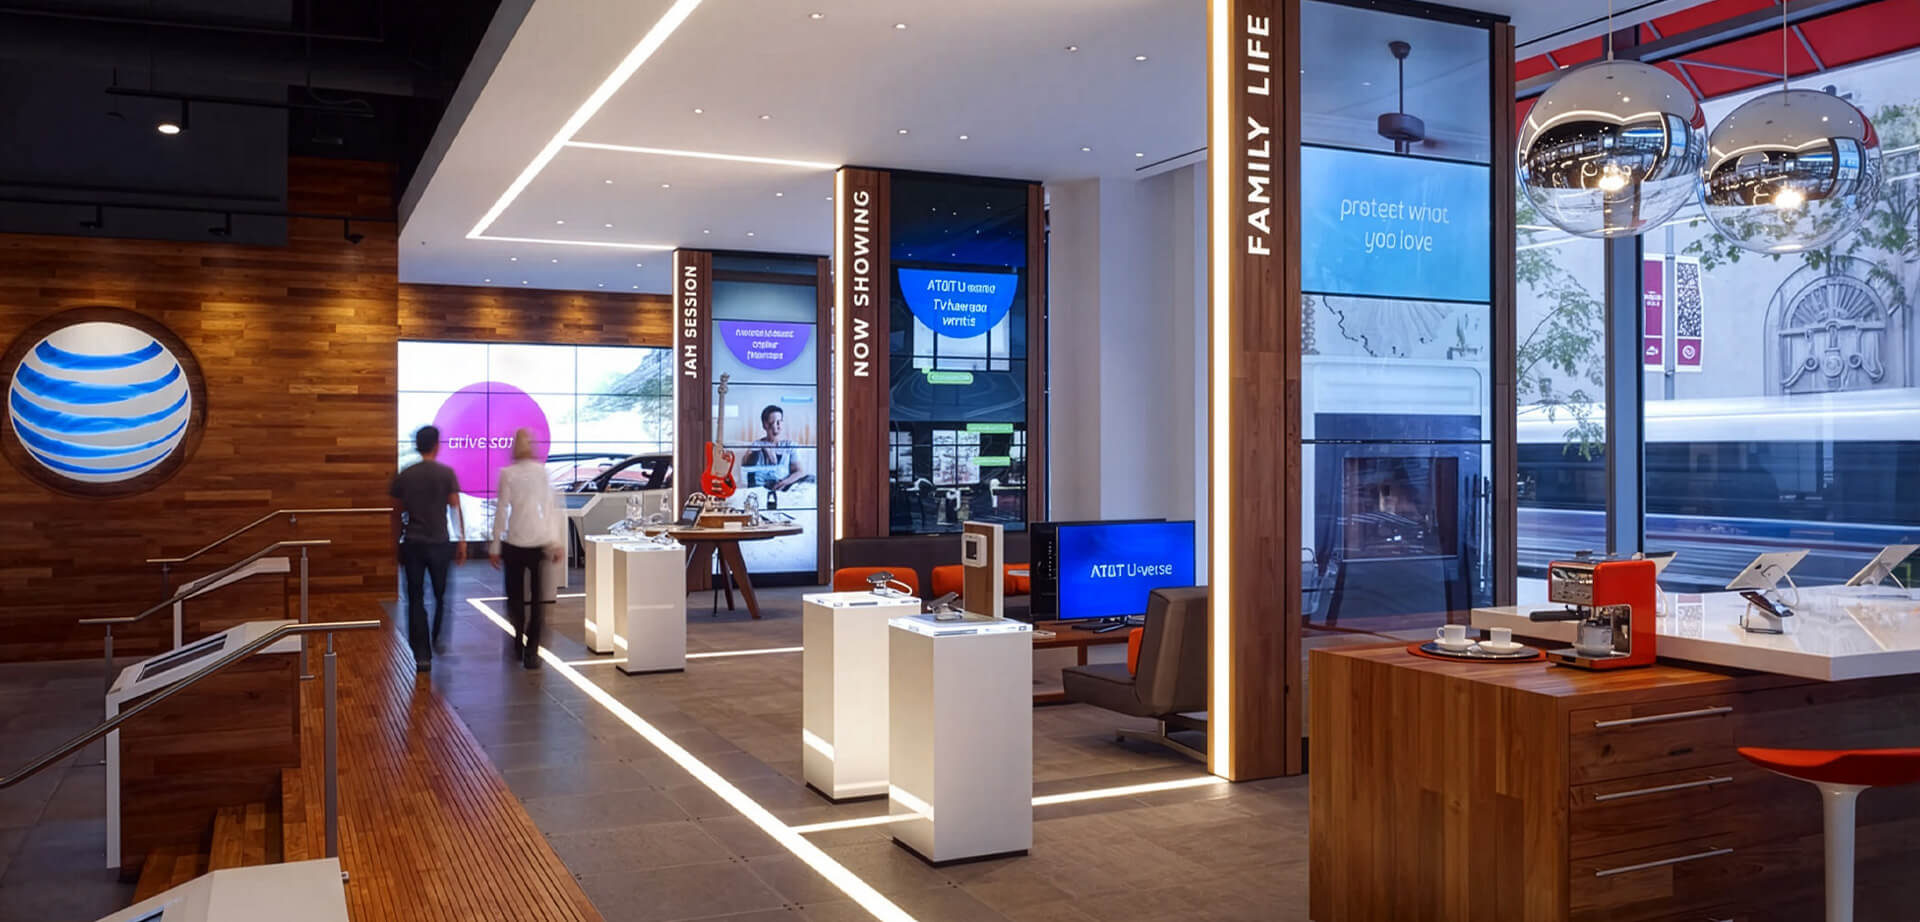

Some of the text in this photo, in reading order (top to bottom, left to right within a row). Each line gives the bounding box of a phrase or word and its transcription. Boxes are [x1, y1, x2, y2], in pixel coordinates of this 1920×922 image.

[1247, 14, 1270, 256] FAMILY LIFE
[853, 190, 870, 377] NOW SHOWING
[1400, 229, 1432, 252] love
[684, 266, 697, 379] JAM SESSION
